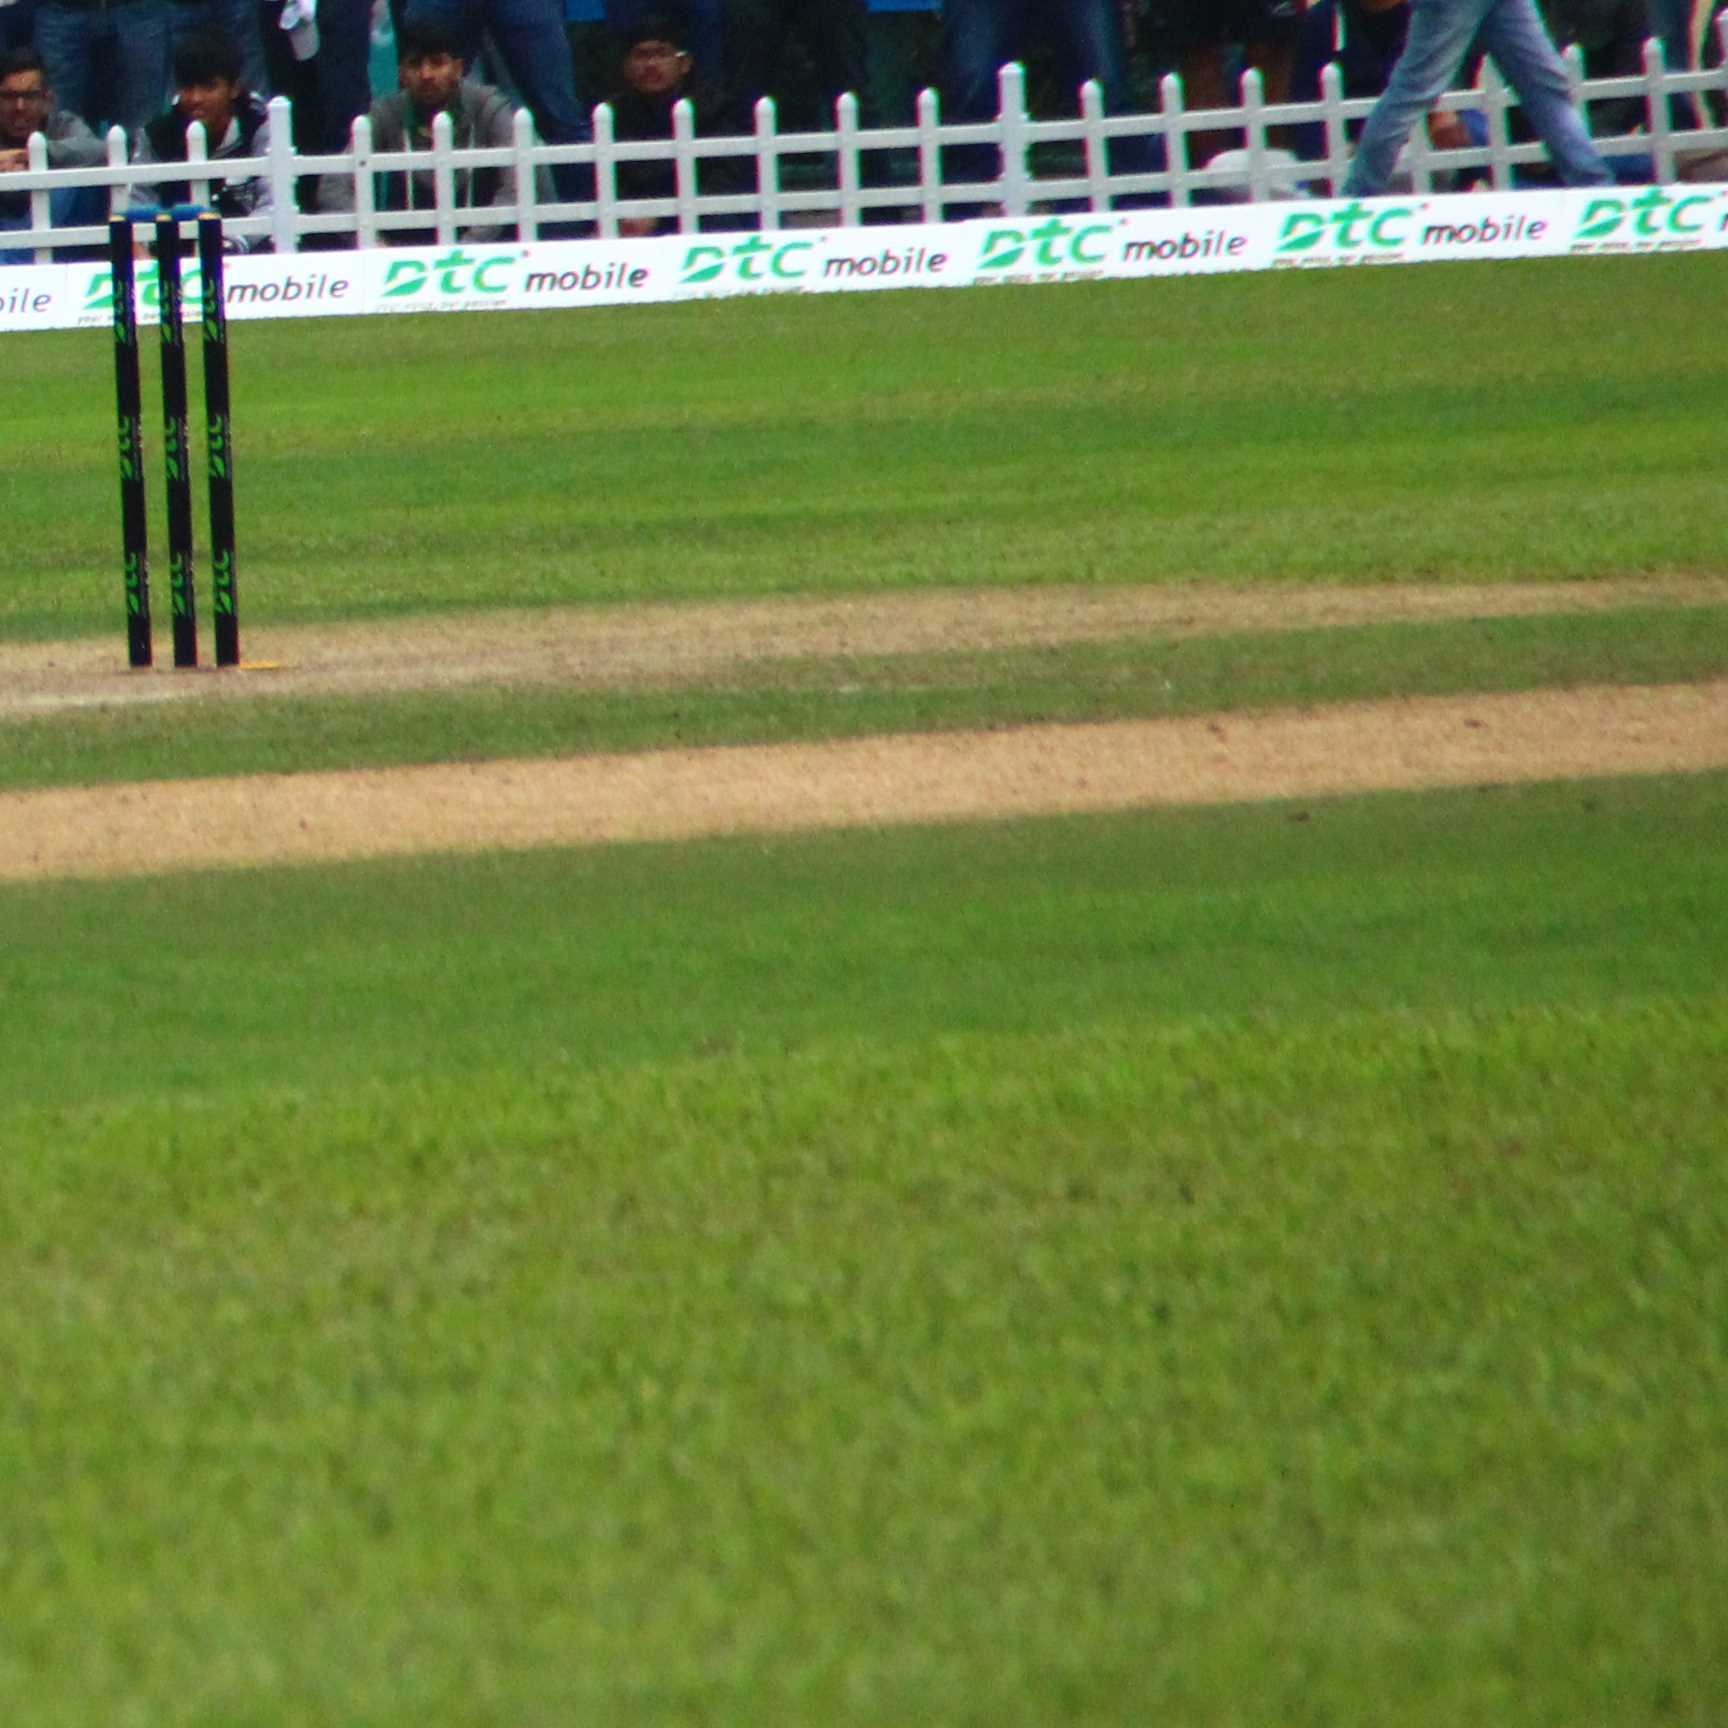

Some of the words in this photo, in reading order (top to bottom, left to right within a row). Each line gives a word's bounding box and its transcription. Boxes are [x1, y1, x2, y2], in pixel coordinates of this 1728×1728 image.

[1124, 229, 1248, 262] mobile
[1423, 215, 1548, 246] mobile
[525, 261, 650, 293] mobile
[824, 247, 948, 278] mobile
[227, 273, 350, 304] mobile
